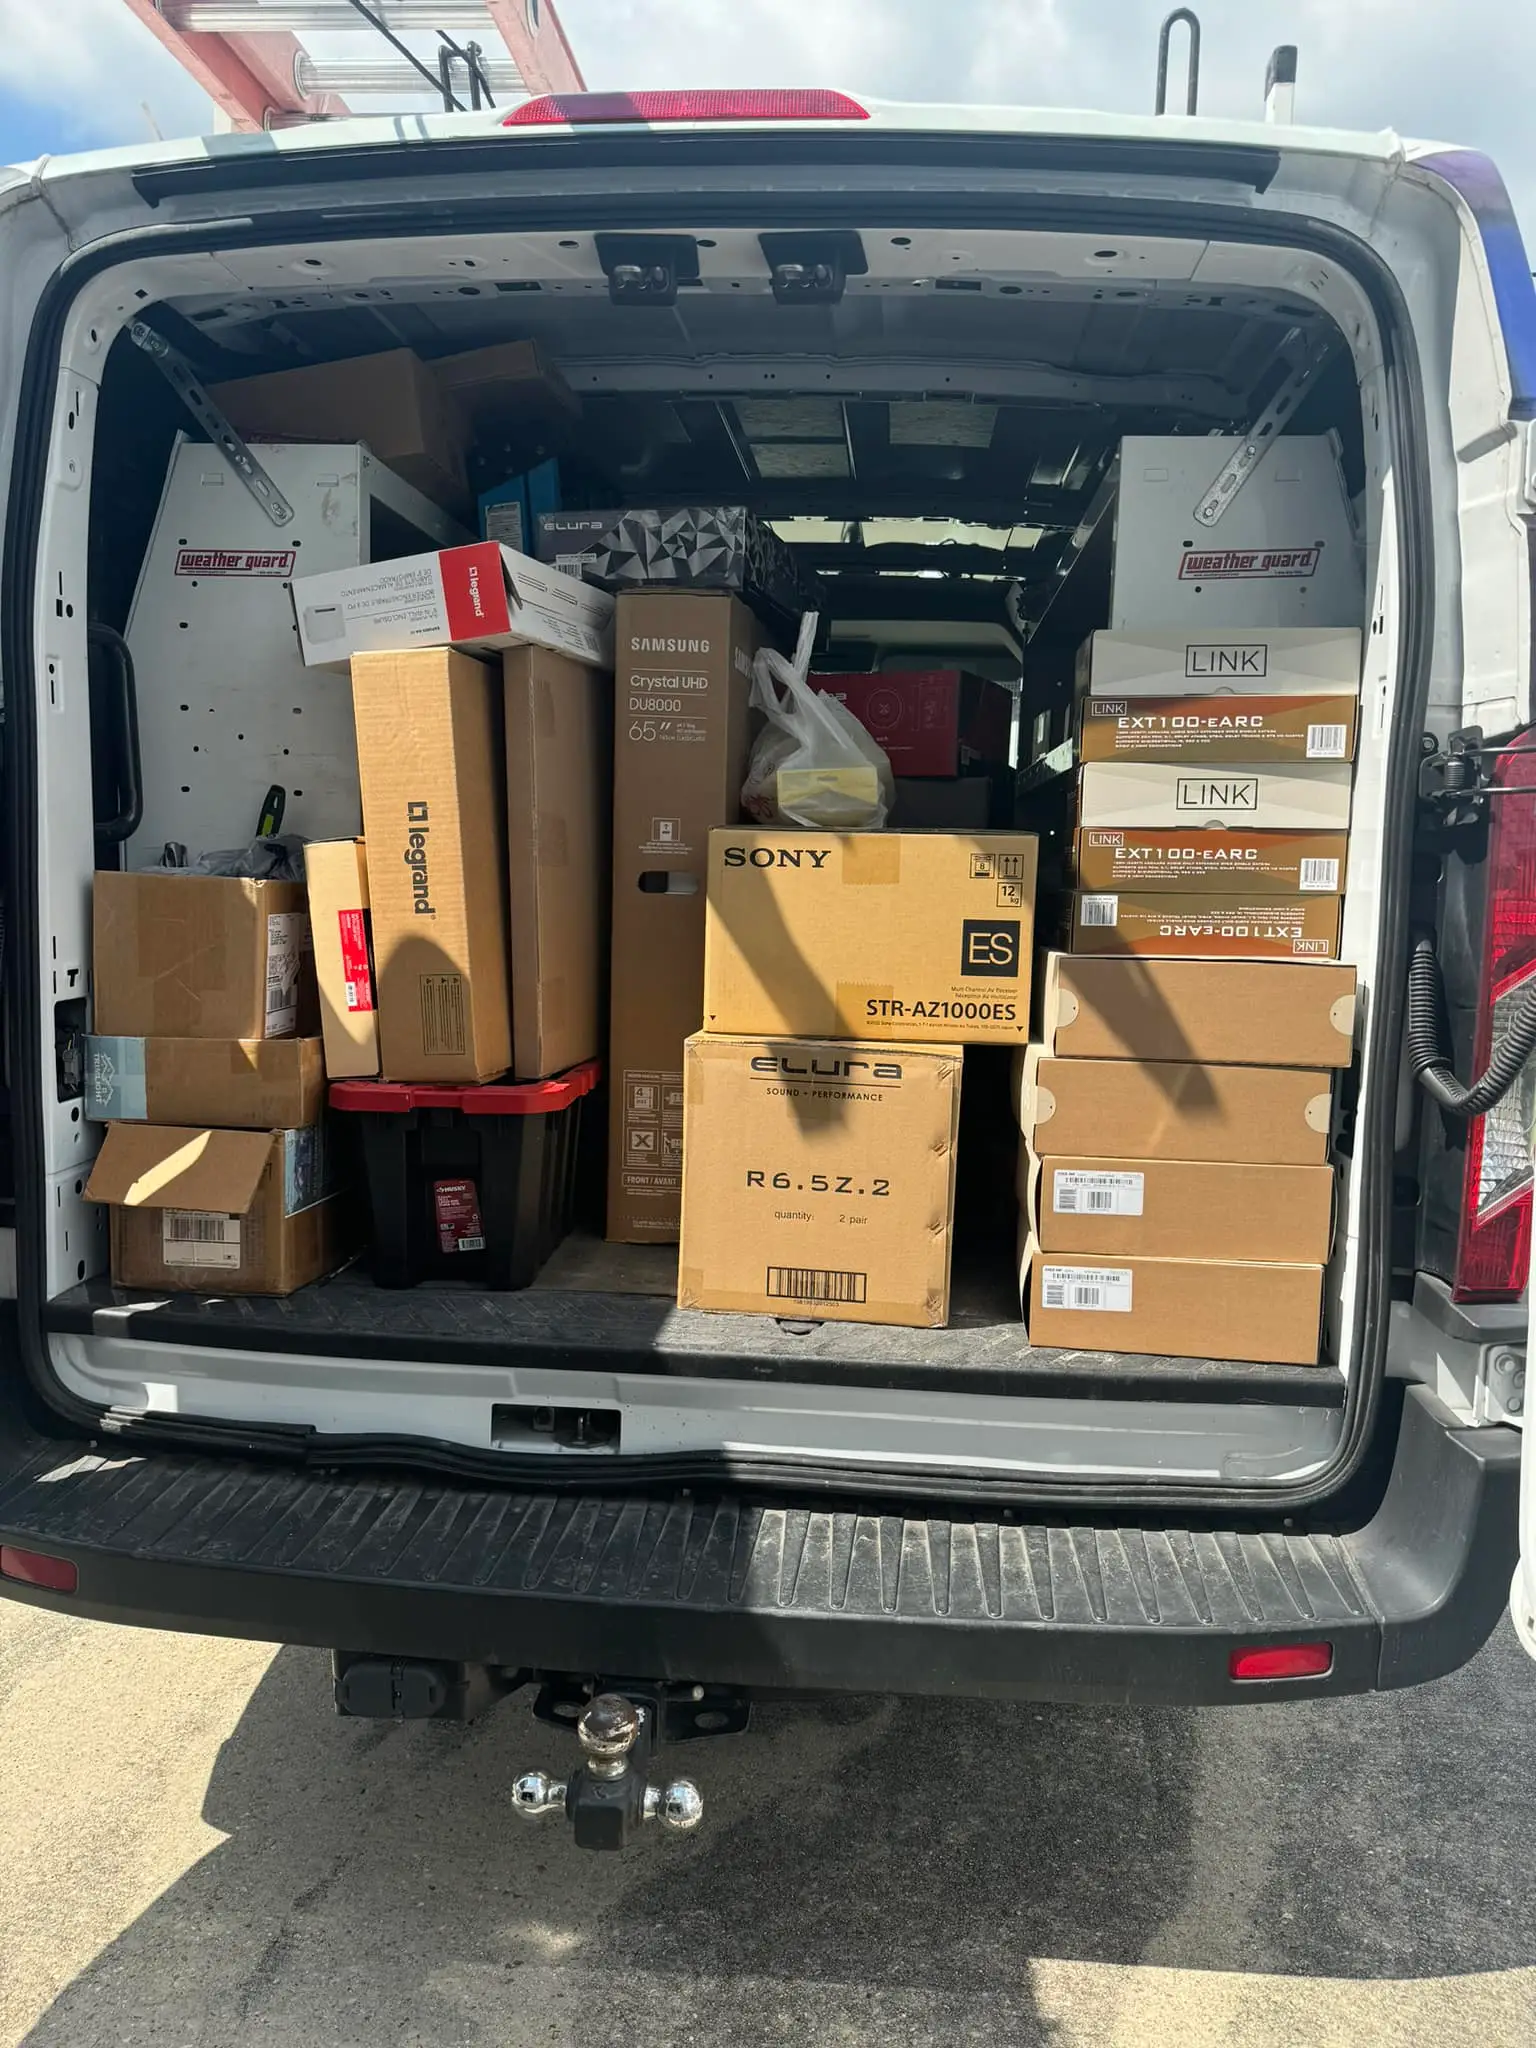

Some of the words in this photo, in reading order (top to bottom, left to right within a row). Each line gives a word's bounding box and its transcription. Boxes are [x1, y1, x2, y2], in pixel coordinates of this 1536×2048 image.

[181, 553, 242, 567] weather
[1187, 553, 1258, 570] weather
[631, 637, 710, 653] SAMSUNG
[1193, 650, 1259, 672] LINK
[630, 675, 679, 691] Crystal
[682, 677, 708, 689] UHD
[629, 697, 681, 712] DU8000
[1095, 704, 1124, 714] LINK
[1184, 784, 1250, 804] LINK
[1091, 835, 1120, 845] LINK
[724, 847, 831, 868] SONY
[404, 827, 436, 914] legrand
[1002, 886, 1015, 896] 12
[969, 933, 1012, 964] ES
[1297, 941, 1326, 951] LINK
[867, 999, 1016, 1020] STR-AZ1000ES
[766, 1087, 799, 1097] SOUND
[812, 1091, 883, 1101] PERFORMANCE
[747, 1170, 890, 1196] R6.5Z.2
[839, 1214, 846, 1223] 2
[849, 1215, 868, 1225] pair
